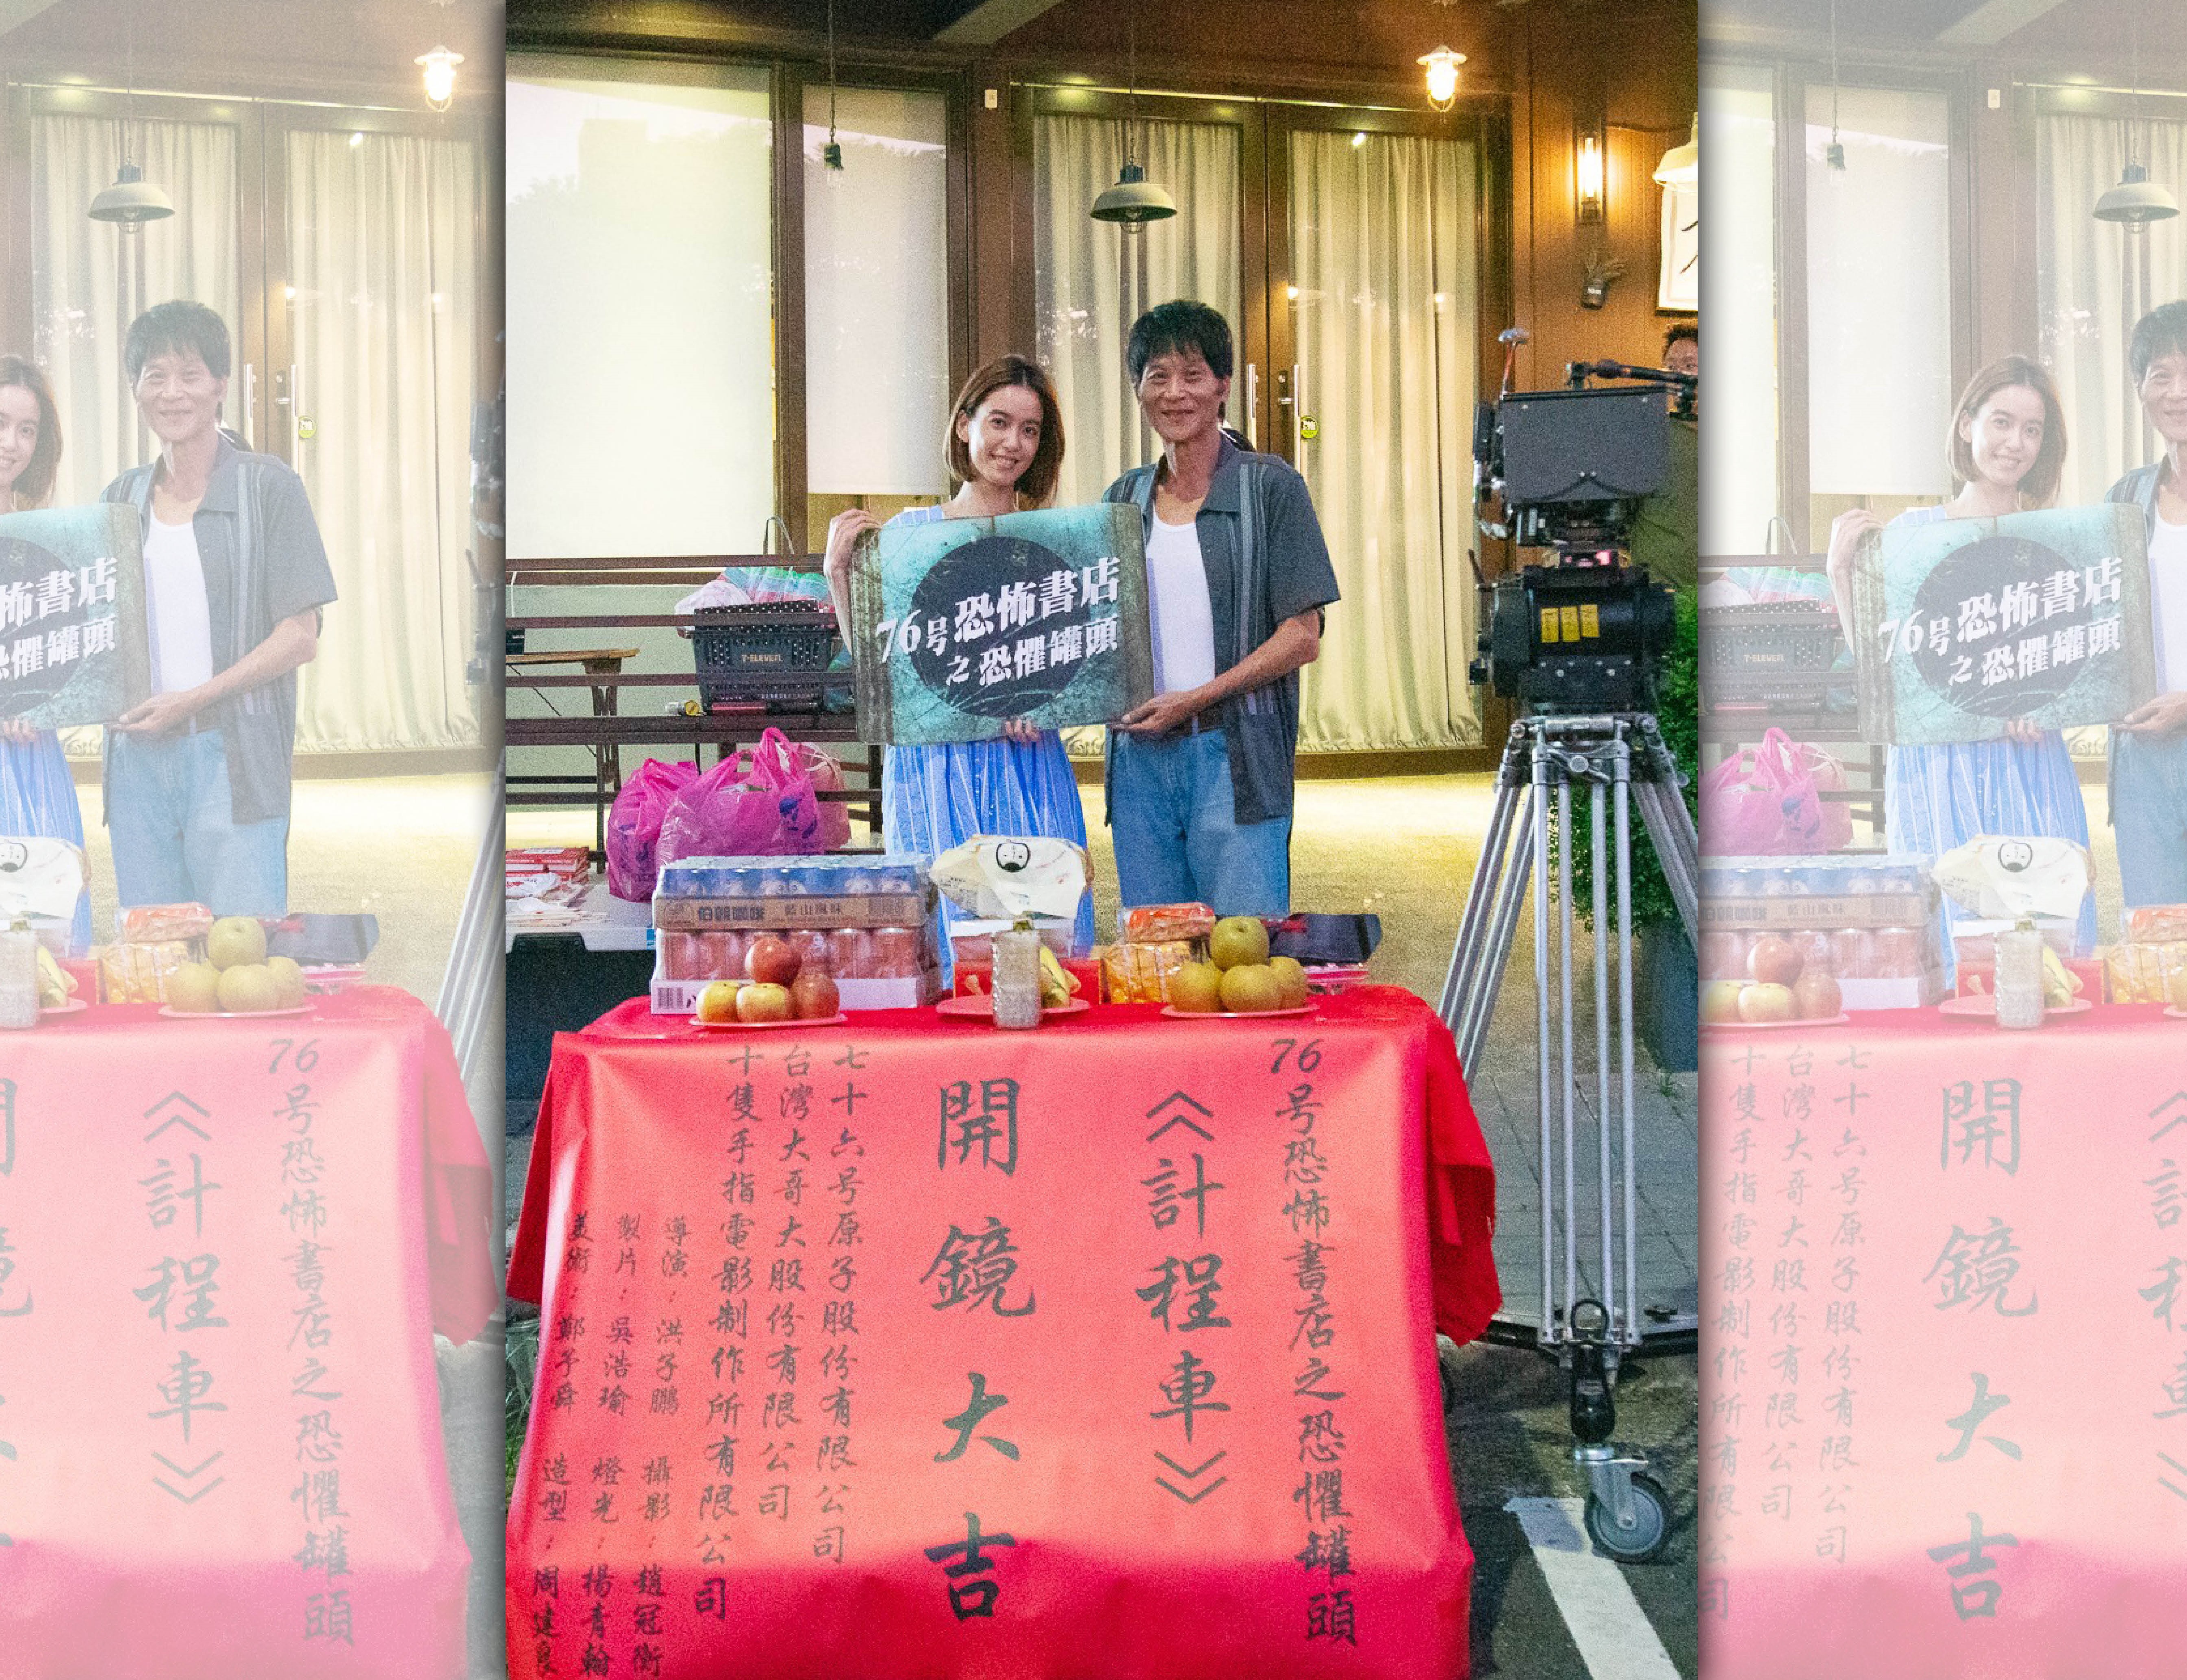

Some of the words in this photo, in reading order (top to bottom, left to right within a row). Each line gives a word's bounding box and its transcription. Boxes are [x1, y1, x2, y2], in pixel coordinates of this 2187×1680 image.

[875, 557, 1121, 663] 76号恐怖書店
[946, 614, 1119, 687] 之恐懼罐頭
[1878, 557, 2123, 663] 76号恐怖書店
[1948, 614, 2122, 687] 之恐懼罐頭
[919, 1077, 1037, 1622] 開鏡大吉
[1270, 1038, 1358, 1647] 76号恐怖書店之恐懼罐頭
[1921, 1077, 2039, 1622] 開鏡大吉
